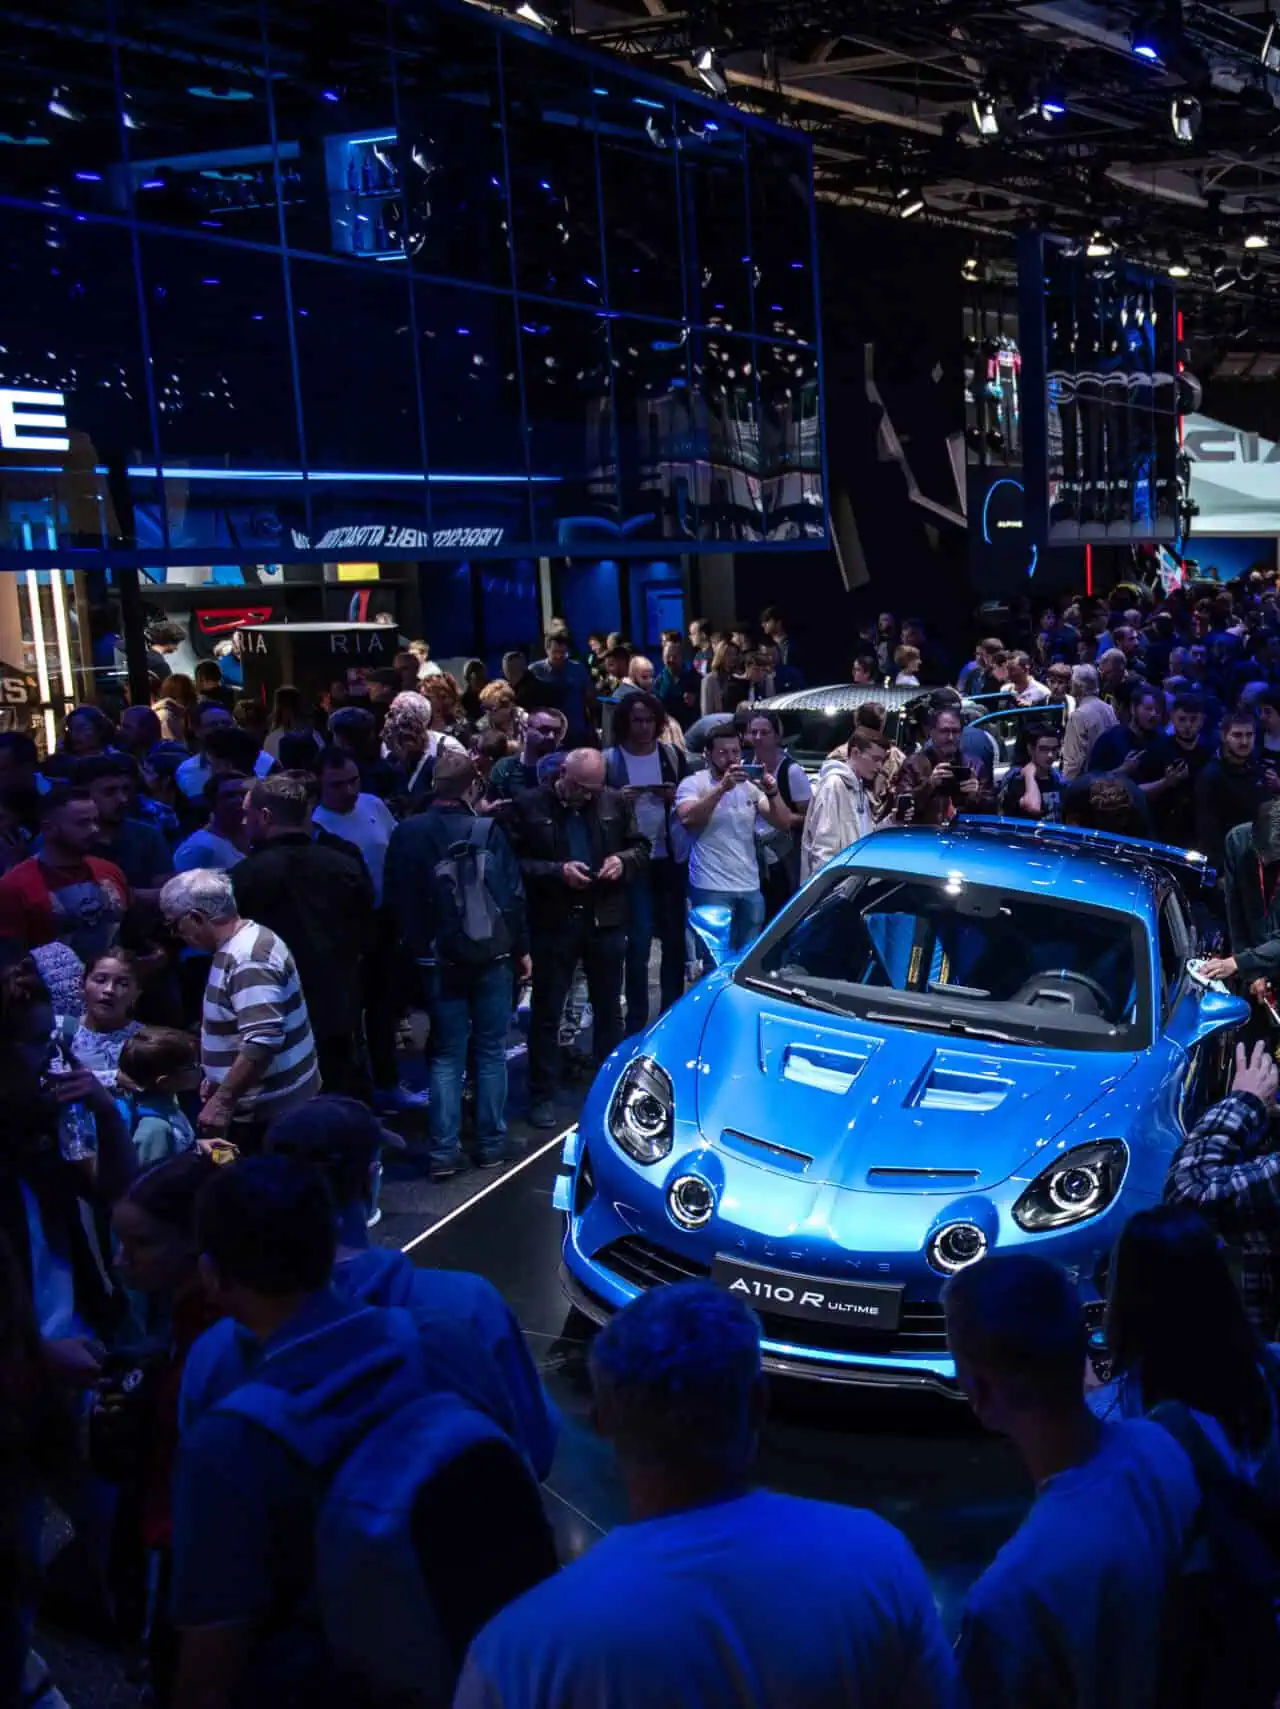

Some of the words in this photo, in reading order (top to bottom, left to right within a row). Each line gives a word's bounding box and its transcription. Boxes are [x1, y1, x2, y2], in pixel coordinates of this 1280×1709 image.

[729, 1277, 795, 1303] A110
[799, 1291, 825, 1308] R
[828, 1301, 880, 1316] ULTIME
